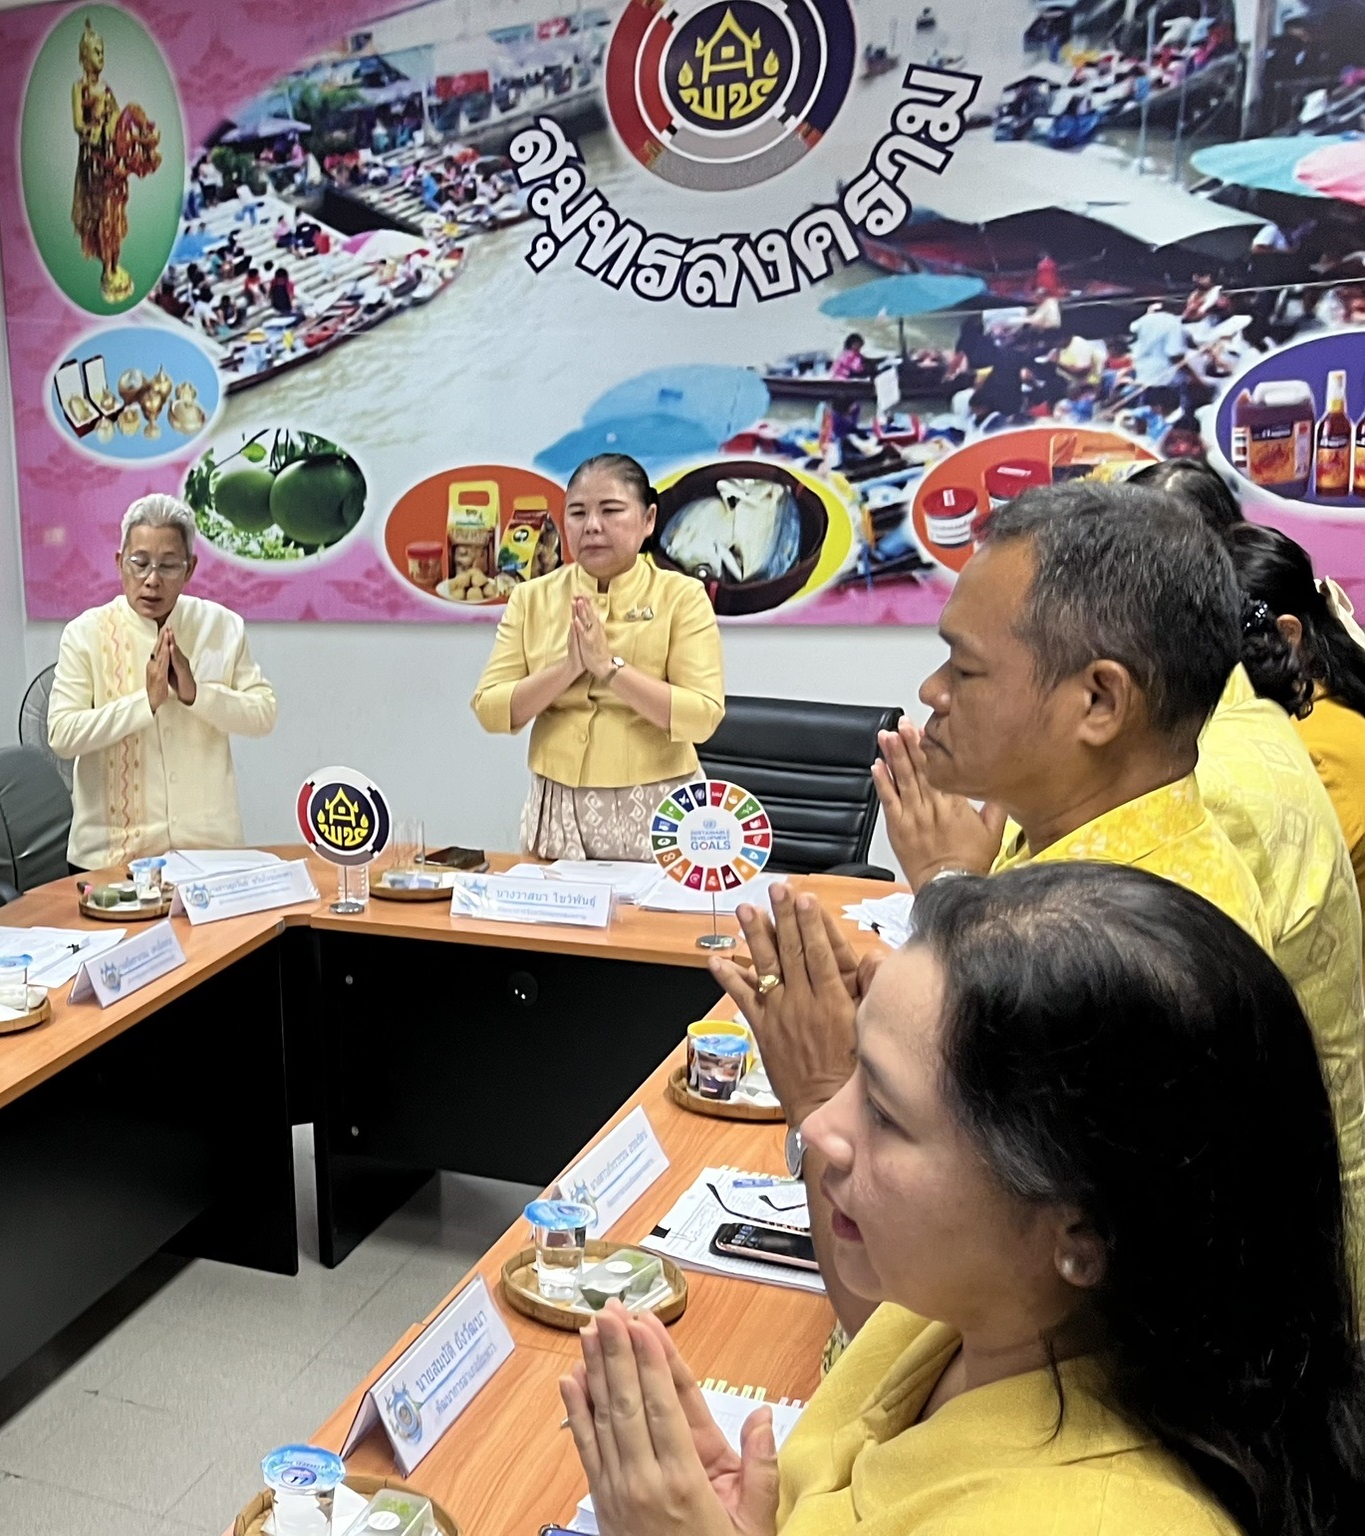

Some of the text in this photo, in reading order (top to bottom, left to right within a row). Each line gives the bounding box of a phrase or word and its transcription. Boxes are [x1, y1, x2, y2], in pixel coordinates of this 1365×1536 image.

[508, 65, 982, 308] สมุทรสงคราม
[690, 841, 731, 851] GOALS
[496, 889, 549, 902] นางวาสนา
[415, 1343, 455, 1394] นายสมบัติ
